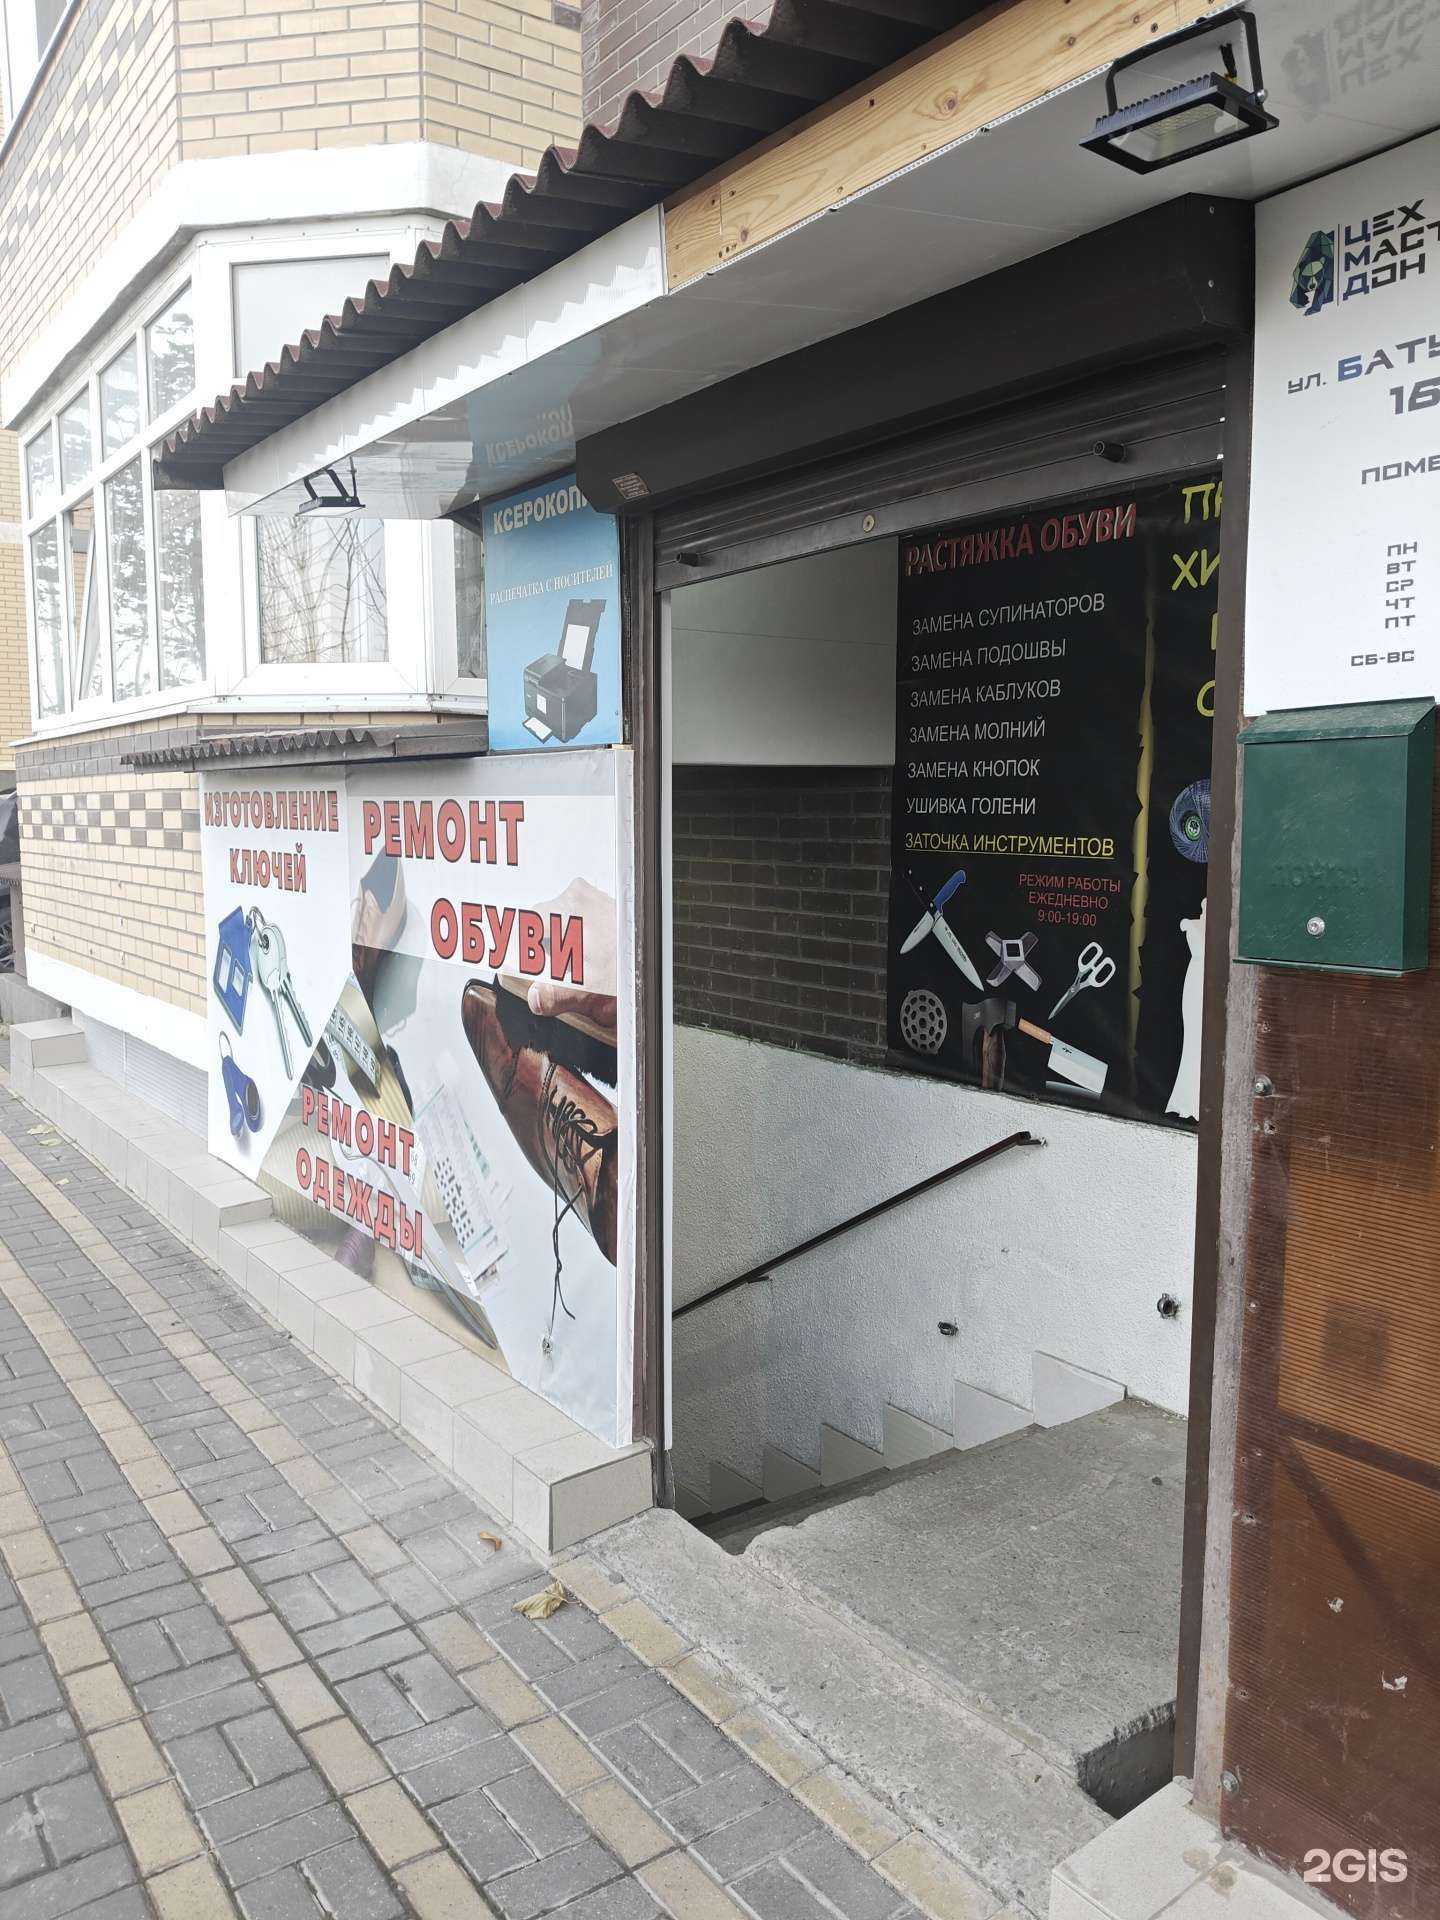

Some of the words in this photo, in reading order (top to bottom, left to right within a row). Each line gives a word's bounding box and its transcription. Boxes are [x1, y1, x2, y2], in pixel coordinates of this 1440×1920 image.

[1344, 199, 1426, 246] ЦЕХ
[493, 484, 588, 535] КСЕРОКОП
[904, 522, 1034, 577] РАСТЯЖКА
[1040, 502, 1137, 551] ОБУВИ
[1387, 541, 1418, 557] ПН
[1386, 560, 1416, 575] ВТ
[489, 581, 544, 606] РАСПЕЧАТКА
[1386, 579, 1414, 593] СР
[912, 611, 974, 636] ЗАМЕНА
[978, 592, 1106, 628] СУПИНАТОРОВ
[1385, 597, 1415, 611] ЧТ
[1385, 615, 1416, 629] ПТ
[911, 649, 973, 672] ЗАМЕНА
[977, 638, 1067, 666] ПОДОШВЫ
[1350, 650, 1415, 667] СБ-ВС
[910, 687, 972, 708] ЗАМЕНА
[976, 678, 1062, 703] КАБЛУКОВ
[909, 724, 970, 743] ЗАМЕНА
[974, 713, 1046, 739] МОЛНИЙ
[907, 761, 969, 779] ЗАМЕНА
[973, 758, 1041, 777] КНОПОК
[204, 790, 339, 832] ИЗГОТОВЛЕНИЕ
[906, 798, 967, 815] УШИВКА
[971, 797, 1036, 815] ГОЛЕНИ
[362, 799, 525, 867] РЕМОНТ
[905, 833, 969, 851] ЗАТОЧКА
[973, 834, 1115, 857] ИНСТРУМЕНТОВ
[229, 842, 307, 893] КЛЮЧЕЙ
[1018, 873, 1065, 889] РЕЖИМ
[1067, 876, 1121, 893] РАБОТЫ
[1028, 891, 1109, 910] ЕЖЕДНЕВНО
[1037, 910, 1098, 927] 9:00-19:00
[430, 898, 584, 985] ОБУВИ
[302, 1083, 415, 1177] РЕМОНТ
[295, 1147, 424, 1260] ОДЕЖДЫ
